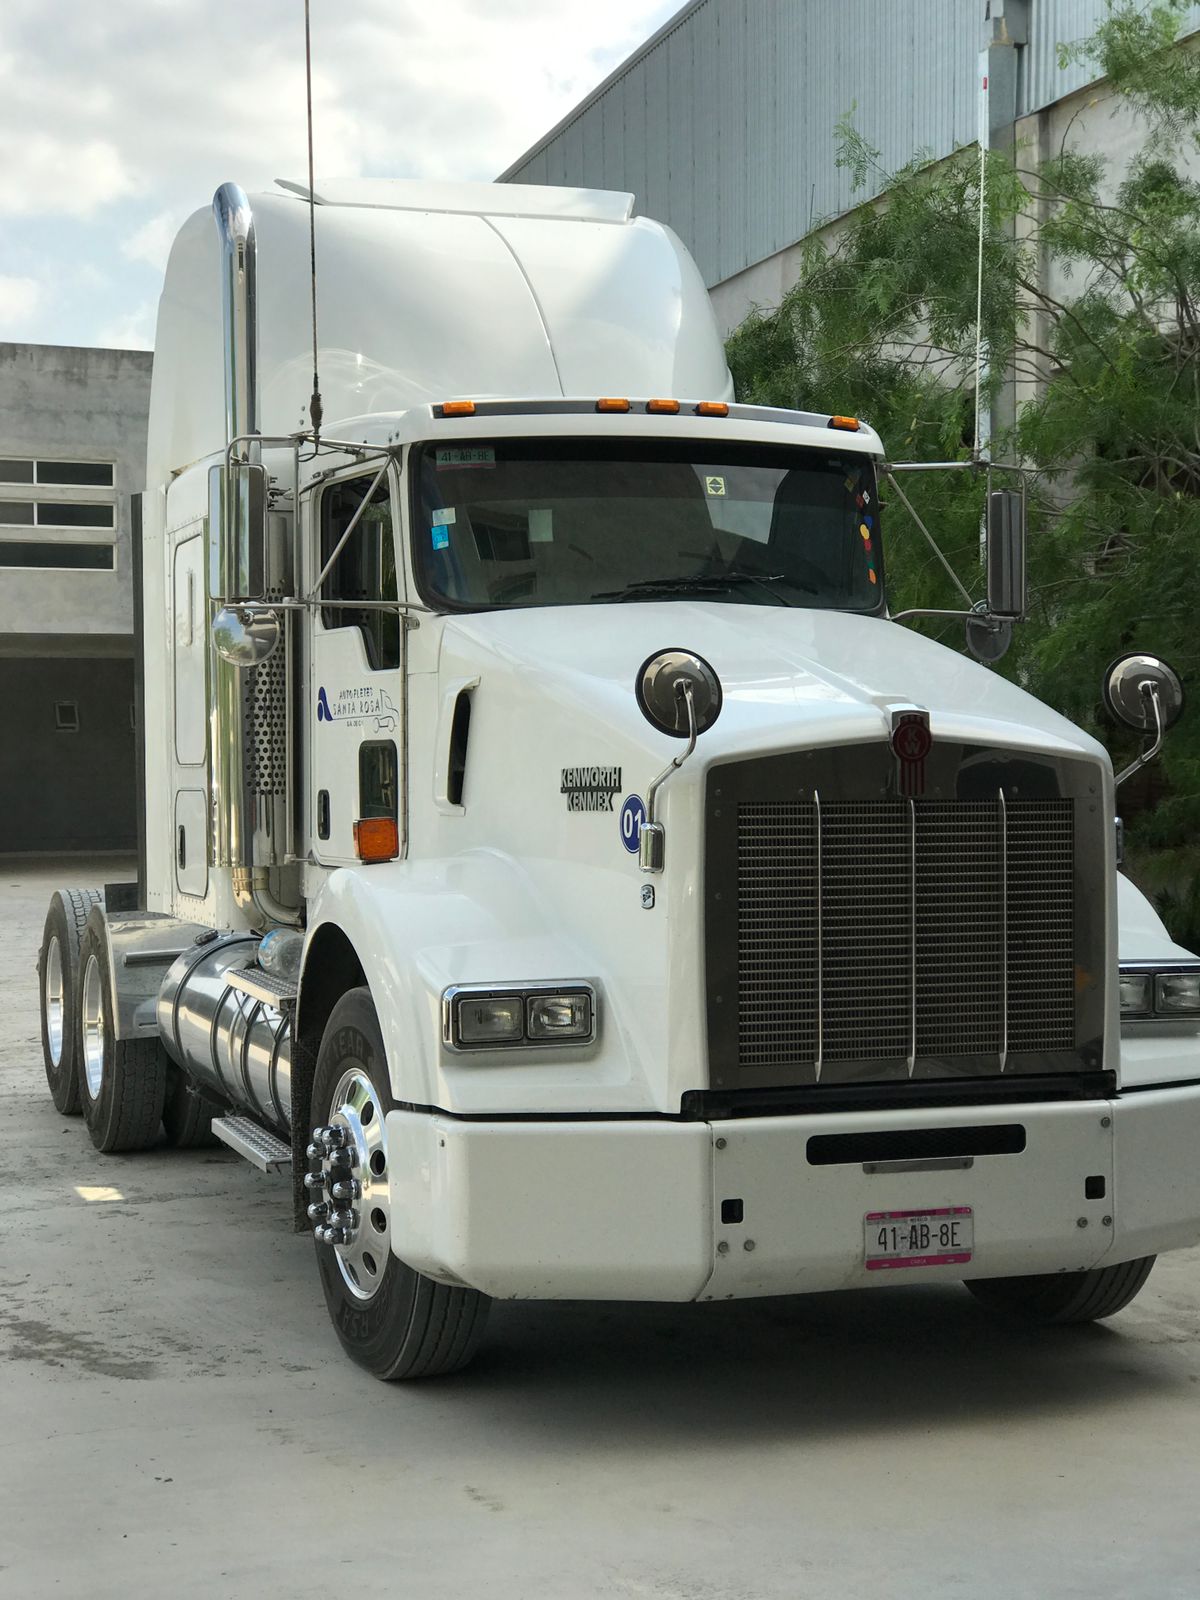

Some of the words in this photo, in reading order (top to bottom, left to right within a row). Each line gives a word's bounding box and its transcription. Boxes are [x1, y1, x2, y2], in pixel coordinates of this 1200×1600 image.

[333, 702, 356, 715] SANTA
[360, 698, 380, 713] ROSA
[561, 766, 622, 788] KENWORTH
[567, 791, 614, 812] KENMEX
[623, 808, 642, 839] 01
[878, 1222, 961, 1252] 41-AB-8E
